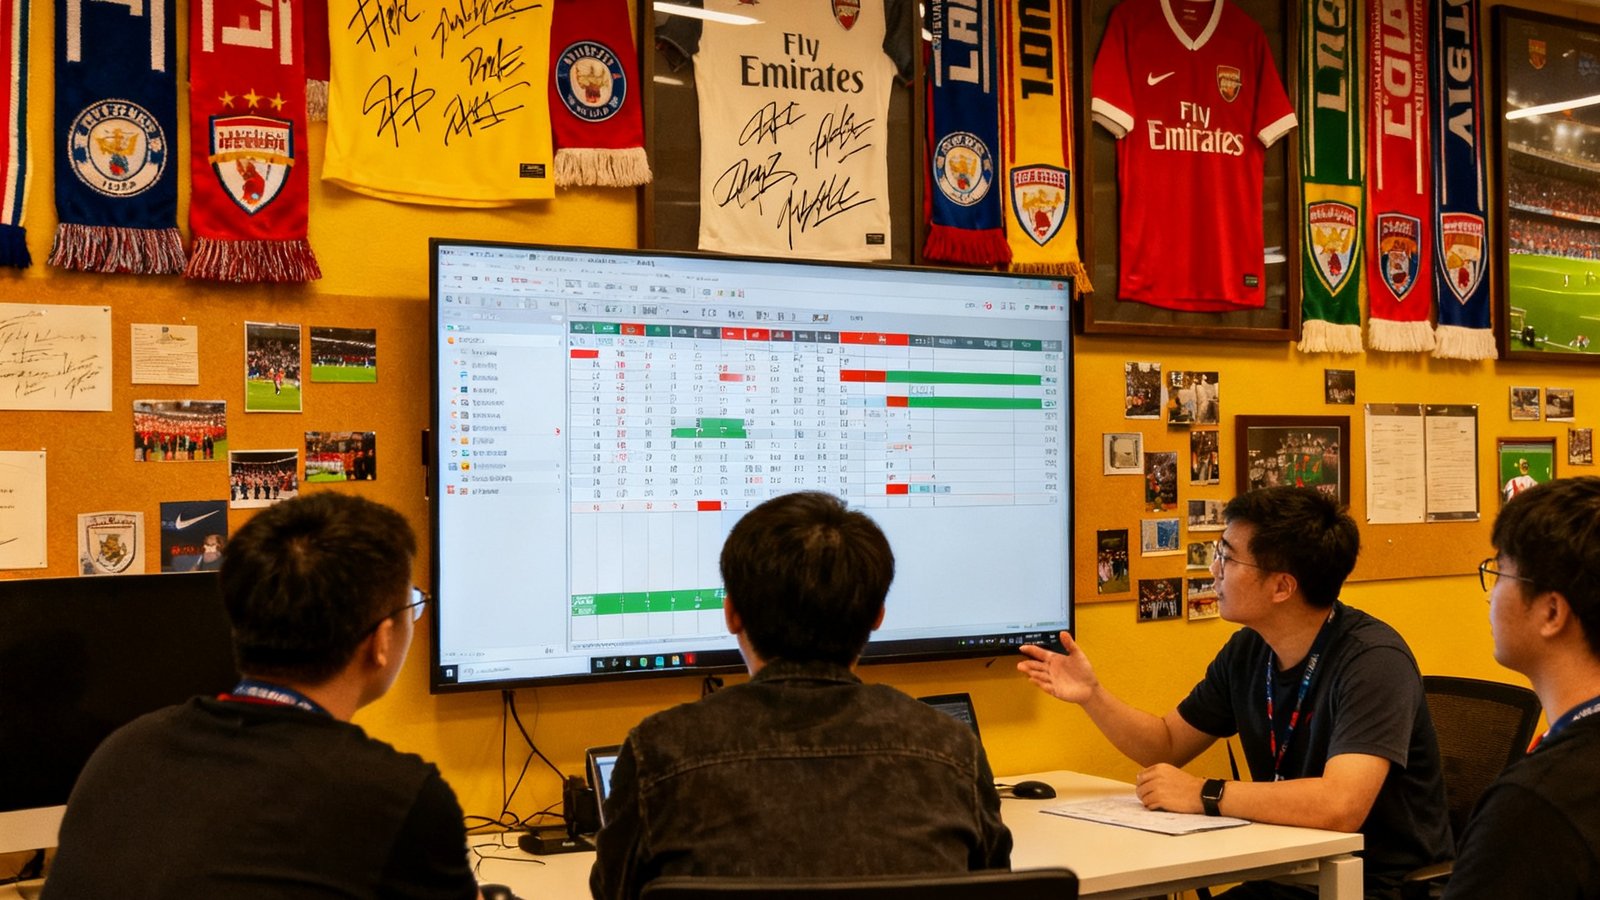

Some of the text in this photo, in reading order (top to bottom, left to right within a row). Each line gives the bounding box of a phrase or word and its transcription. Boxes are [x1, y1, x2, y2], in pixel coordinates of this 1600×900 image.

[782, 31, 820, 62] Fly
[739, 54, 864, 94] Emirates
[1180, 100, 1211, 129] Fly
[1146, 119, 1245, 156] Emirates
